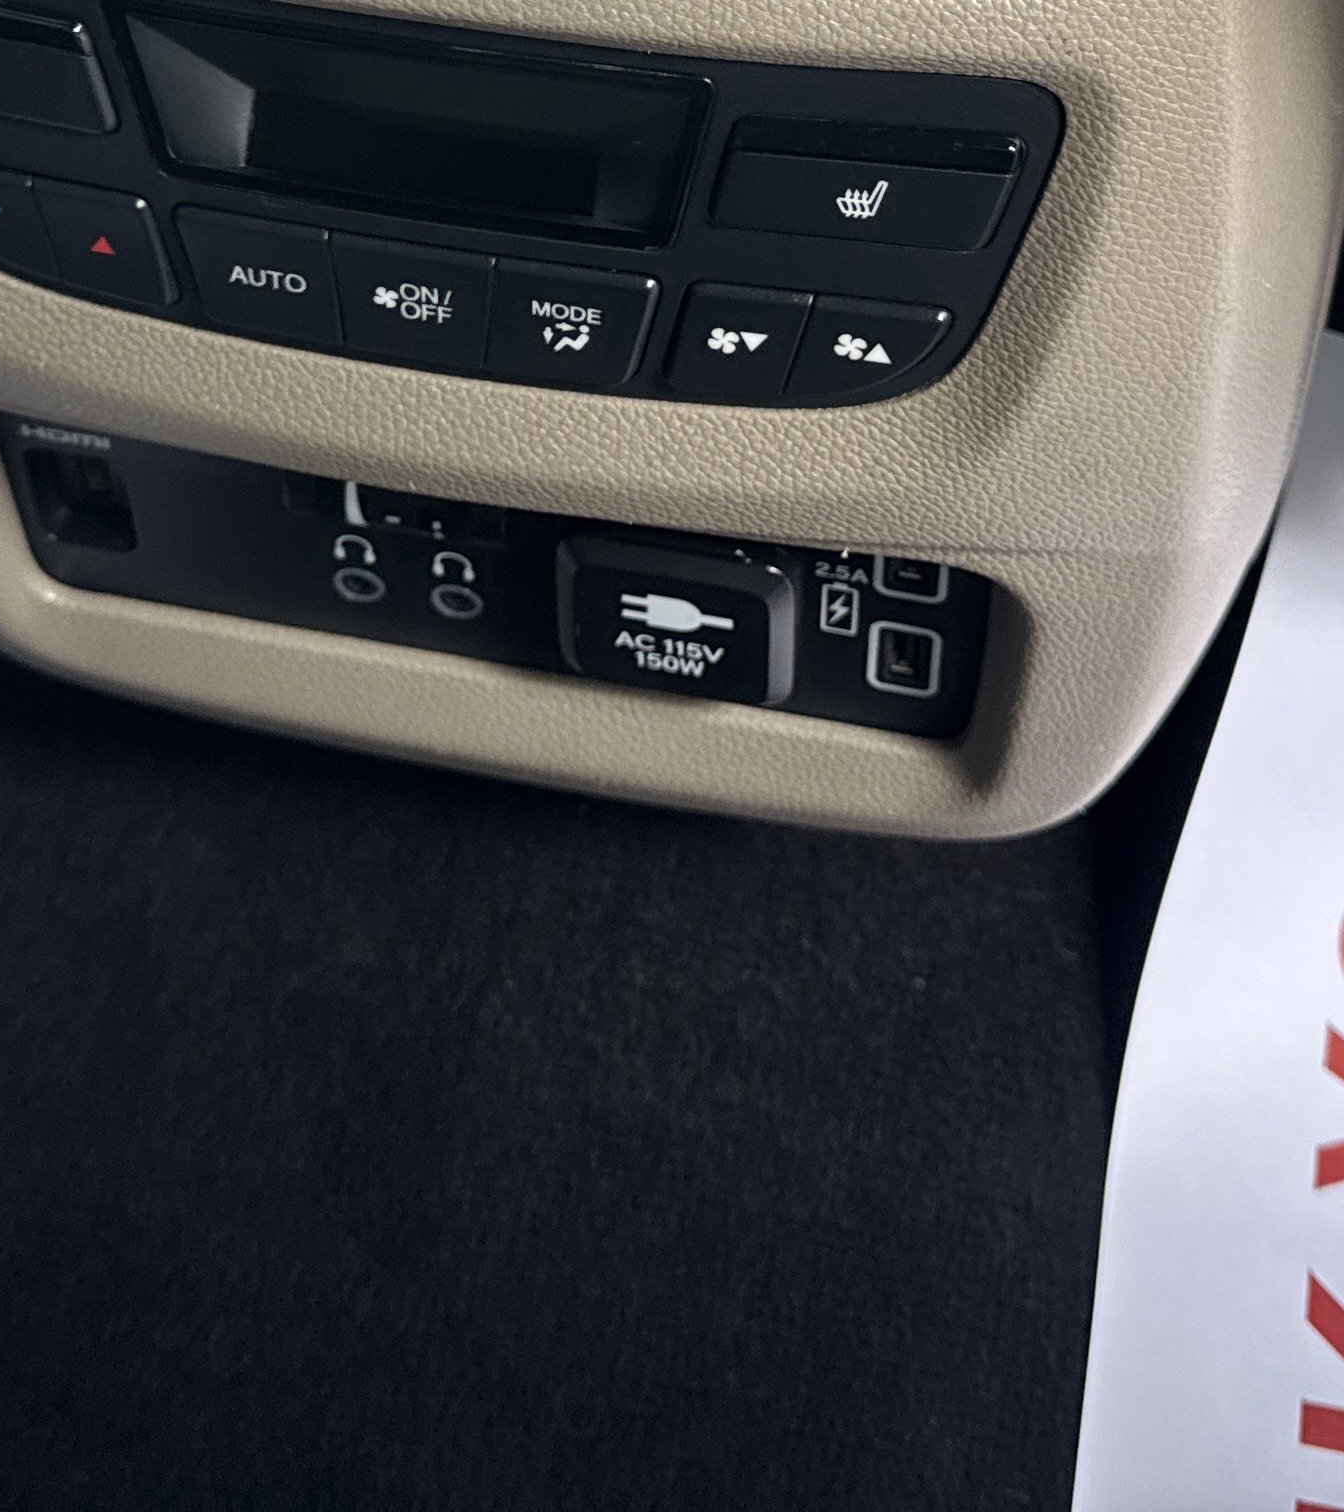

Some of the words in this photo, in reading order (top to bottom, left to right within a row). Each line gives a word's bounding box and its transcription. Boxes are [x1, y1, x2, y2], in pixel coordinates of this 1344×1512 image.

[229, 265, 307, 294] AUTO
[400, 299, 453, 326] OFF
[531, 299, 602, 327] MODE
[813, 560, 869, 586] 2.5A
[614, 630, 656, 652] AC
[663, 638, 725, 665] 115V
[633, 649, 705, 679] 150W
